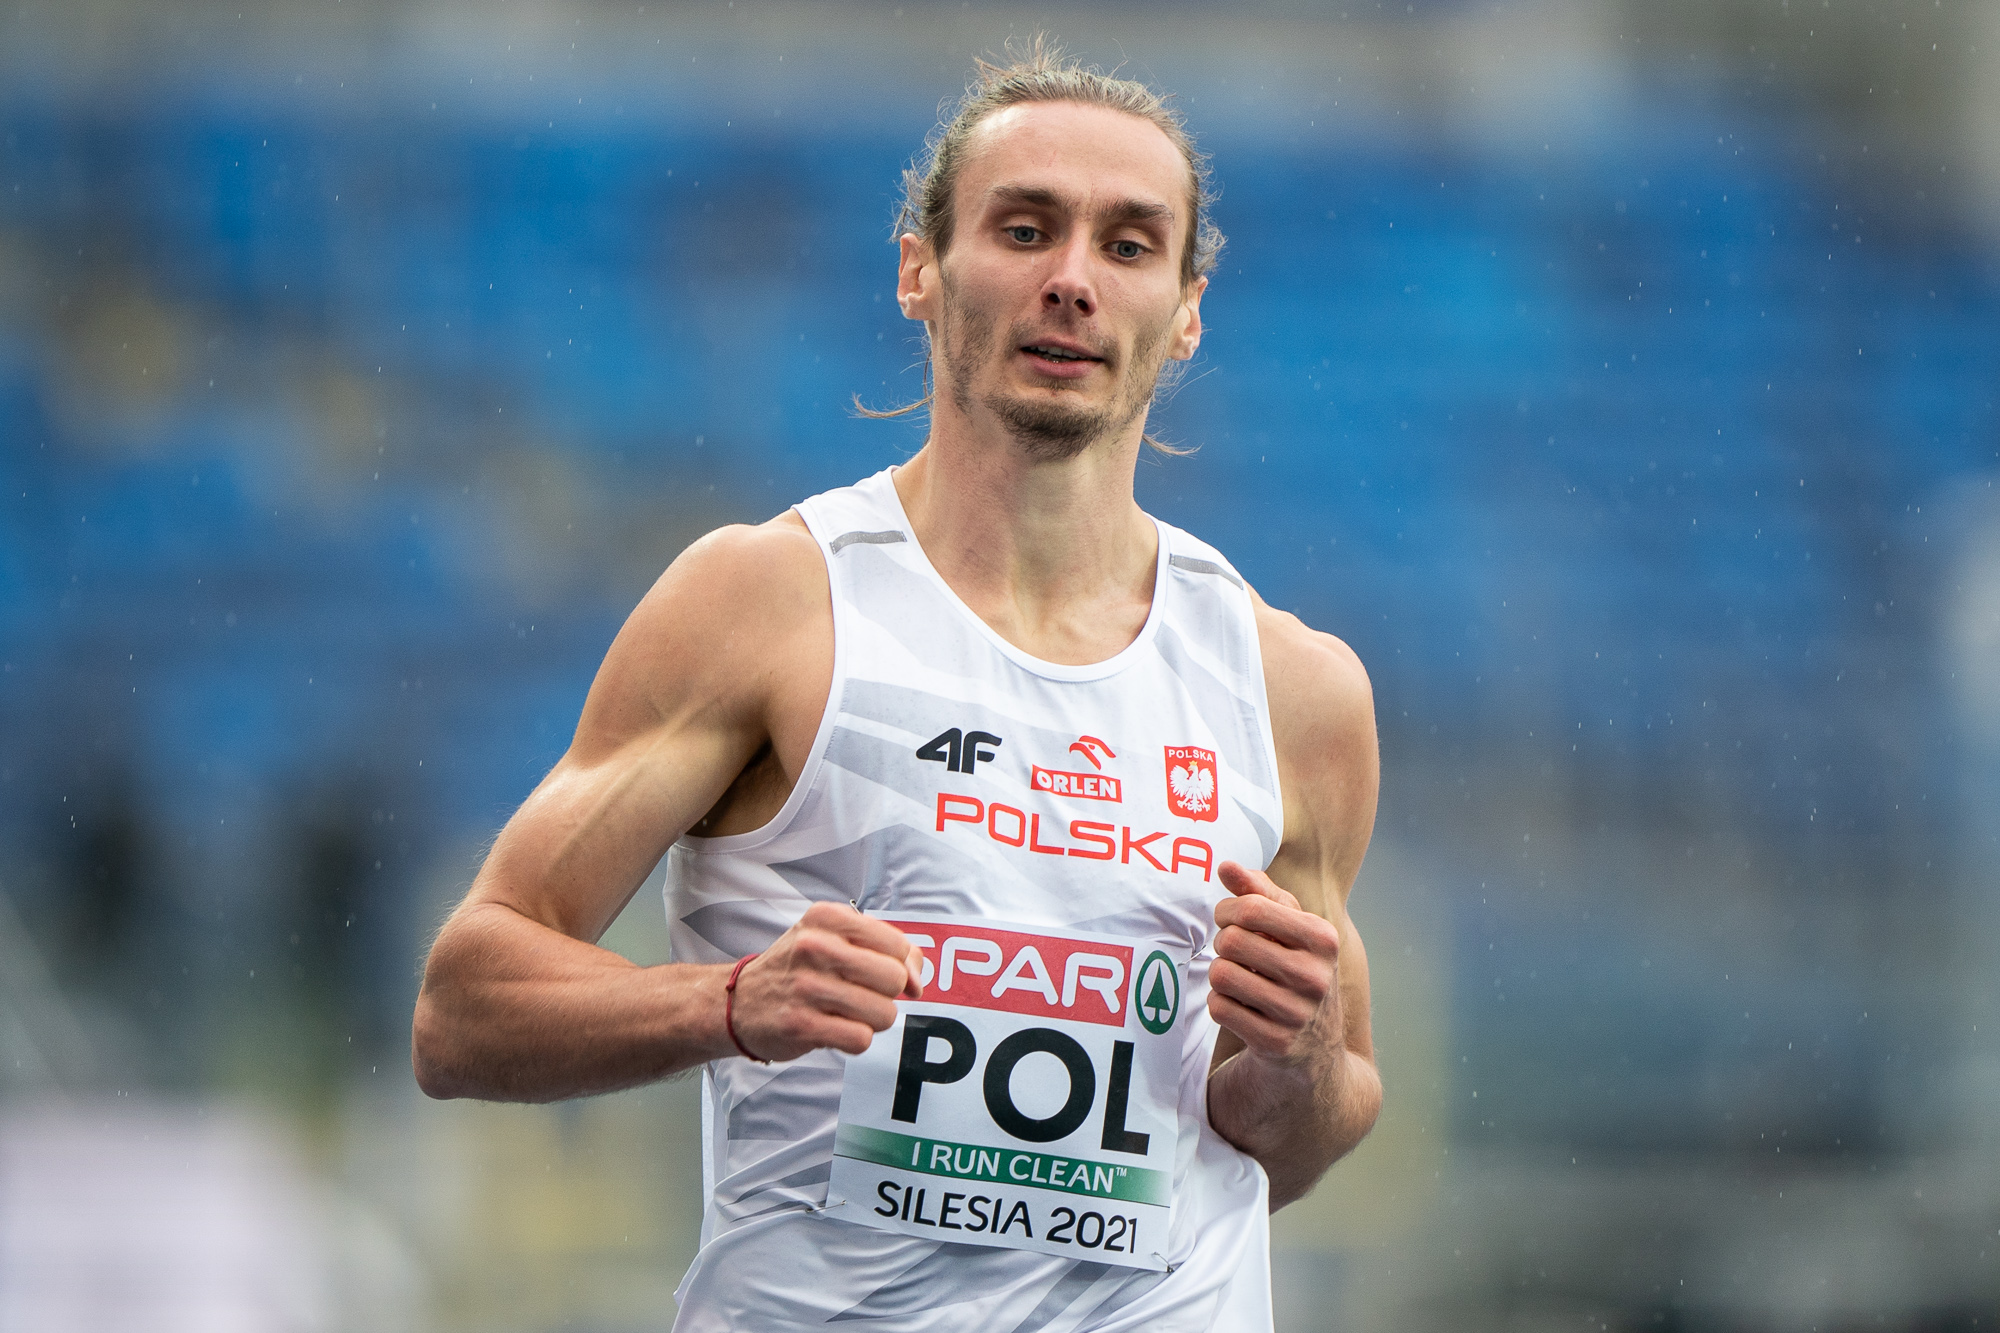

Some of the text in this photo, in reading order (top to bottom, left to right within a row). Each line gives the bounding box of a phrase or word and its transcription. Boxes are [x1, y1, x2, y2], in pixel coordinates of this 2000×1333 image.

[915, 727, 1003, 775] 4F
[1168, 749, 1214, 763] POLSKA
[1036, 771, 1117, 799] ORLEN
[935, 792, 1214, 883] POLSKA
[890, 1013, 1151, 1156] POL
[911, 1141, 922, 1166] I
[929, 1144, 1001, 1177] RUN
[874, 1180, 1138, 1254] SILESIA 2021
